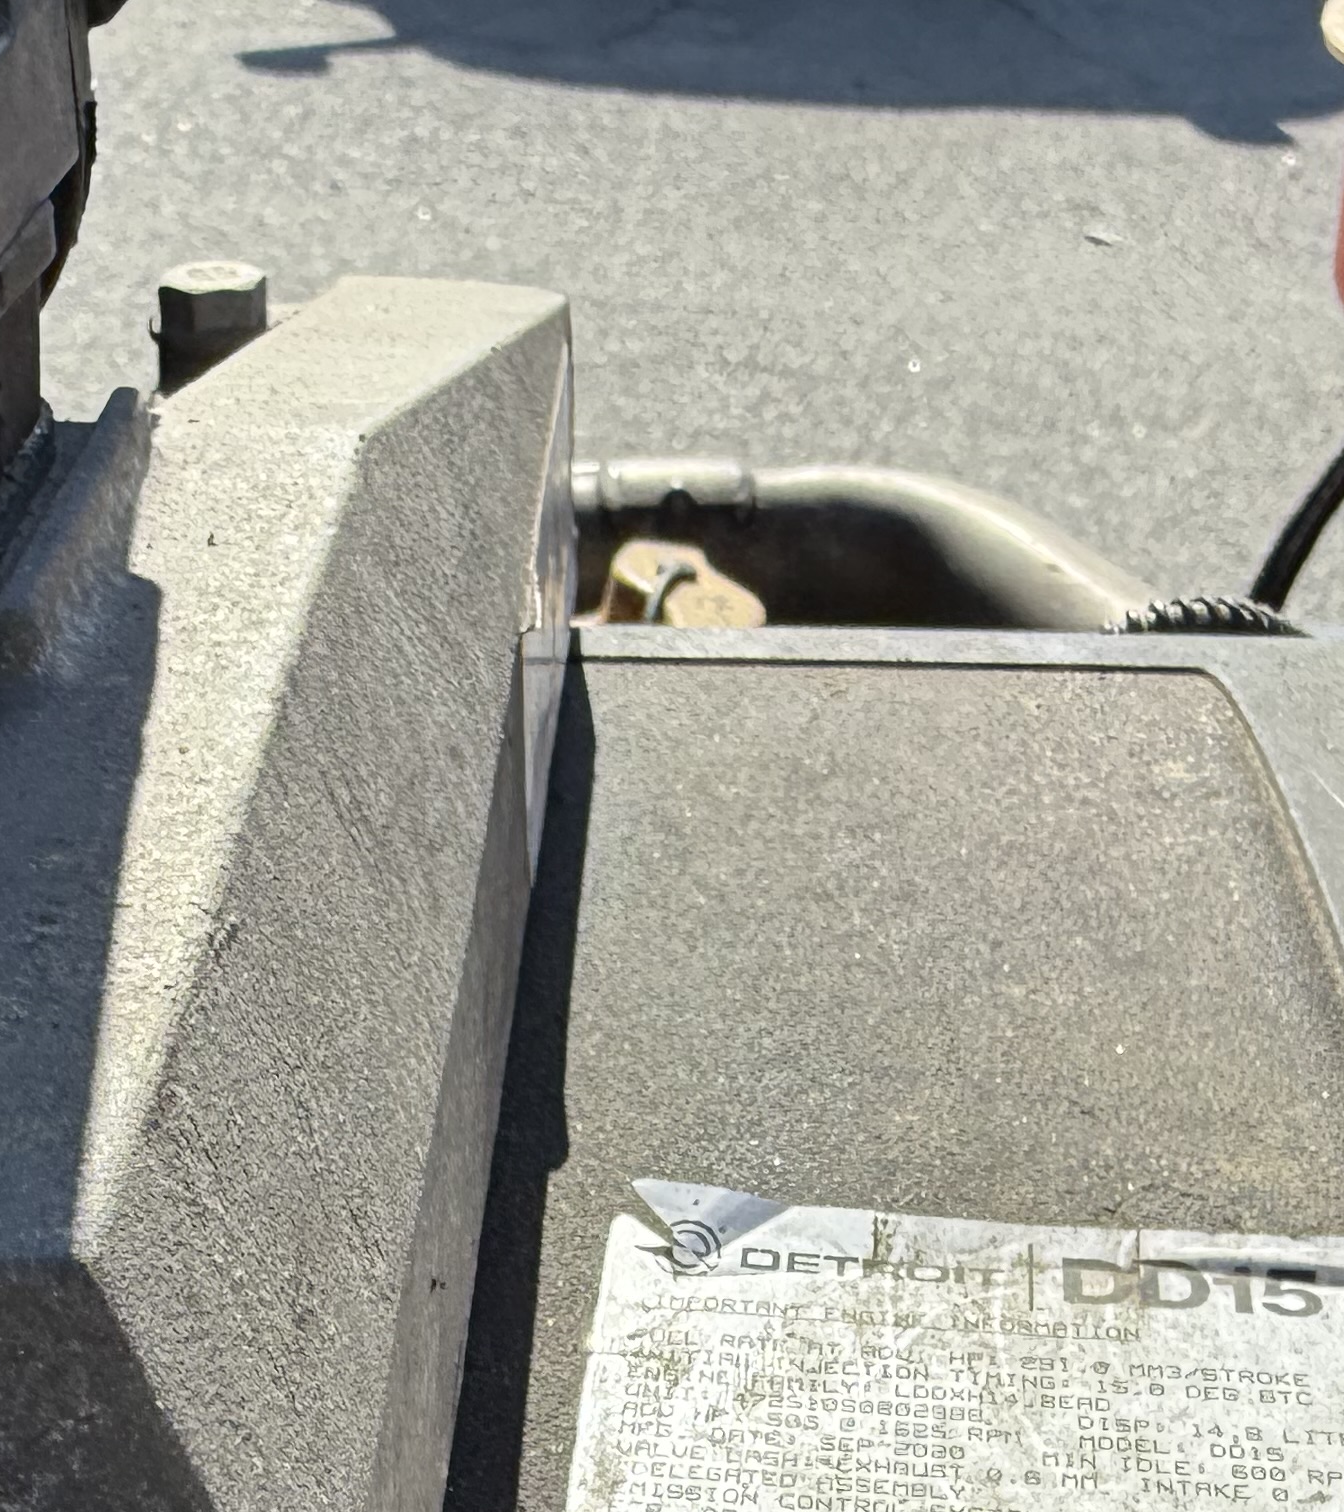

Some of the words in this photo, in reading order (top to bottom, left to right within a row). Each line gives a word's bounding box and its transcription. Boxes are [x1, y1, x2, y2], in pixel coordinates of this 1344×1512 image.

[740, 1247, 1005, 1287] DETROIT
[1062, 1256, 1324, 1318] DD15
[1128, 1363, 1310, 1387] MM3/STROKE
[1209, 1444, 1285, 1462] DD15
[631, 1461, 798, 1488] DELEGATED
[1061, 1471, 1098, 1490] MM
[1140, 1478, 1253, 1500] INTAKE
[1231, 1464, 1286, 1482] 600
